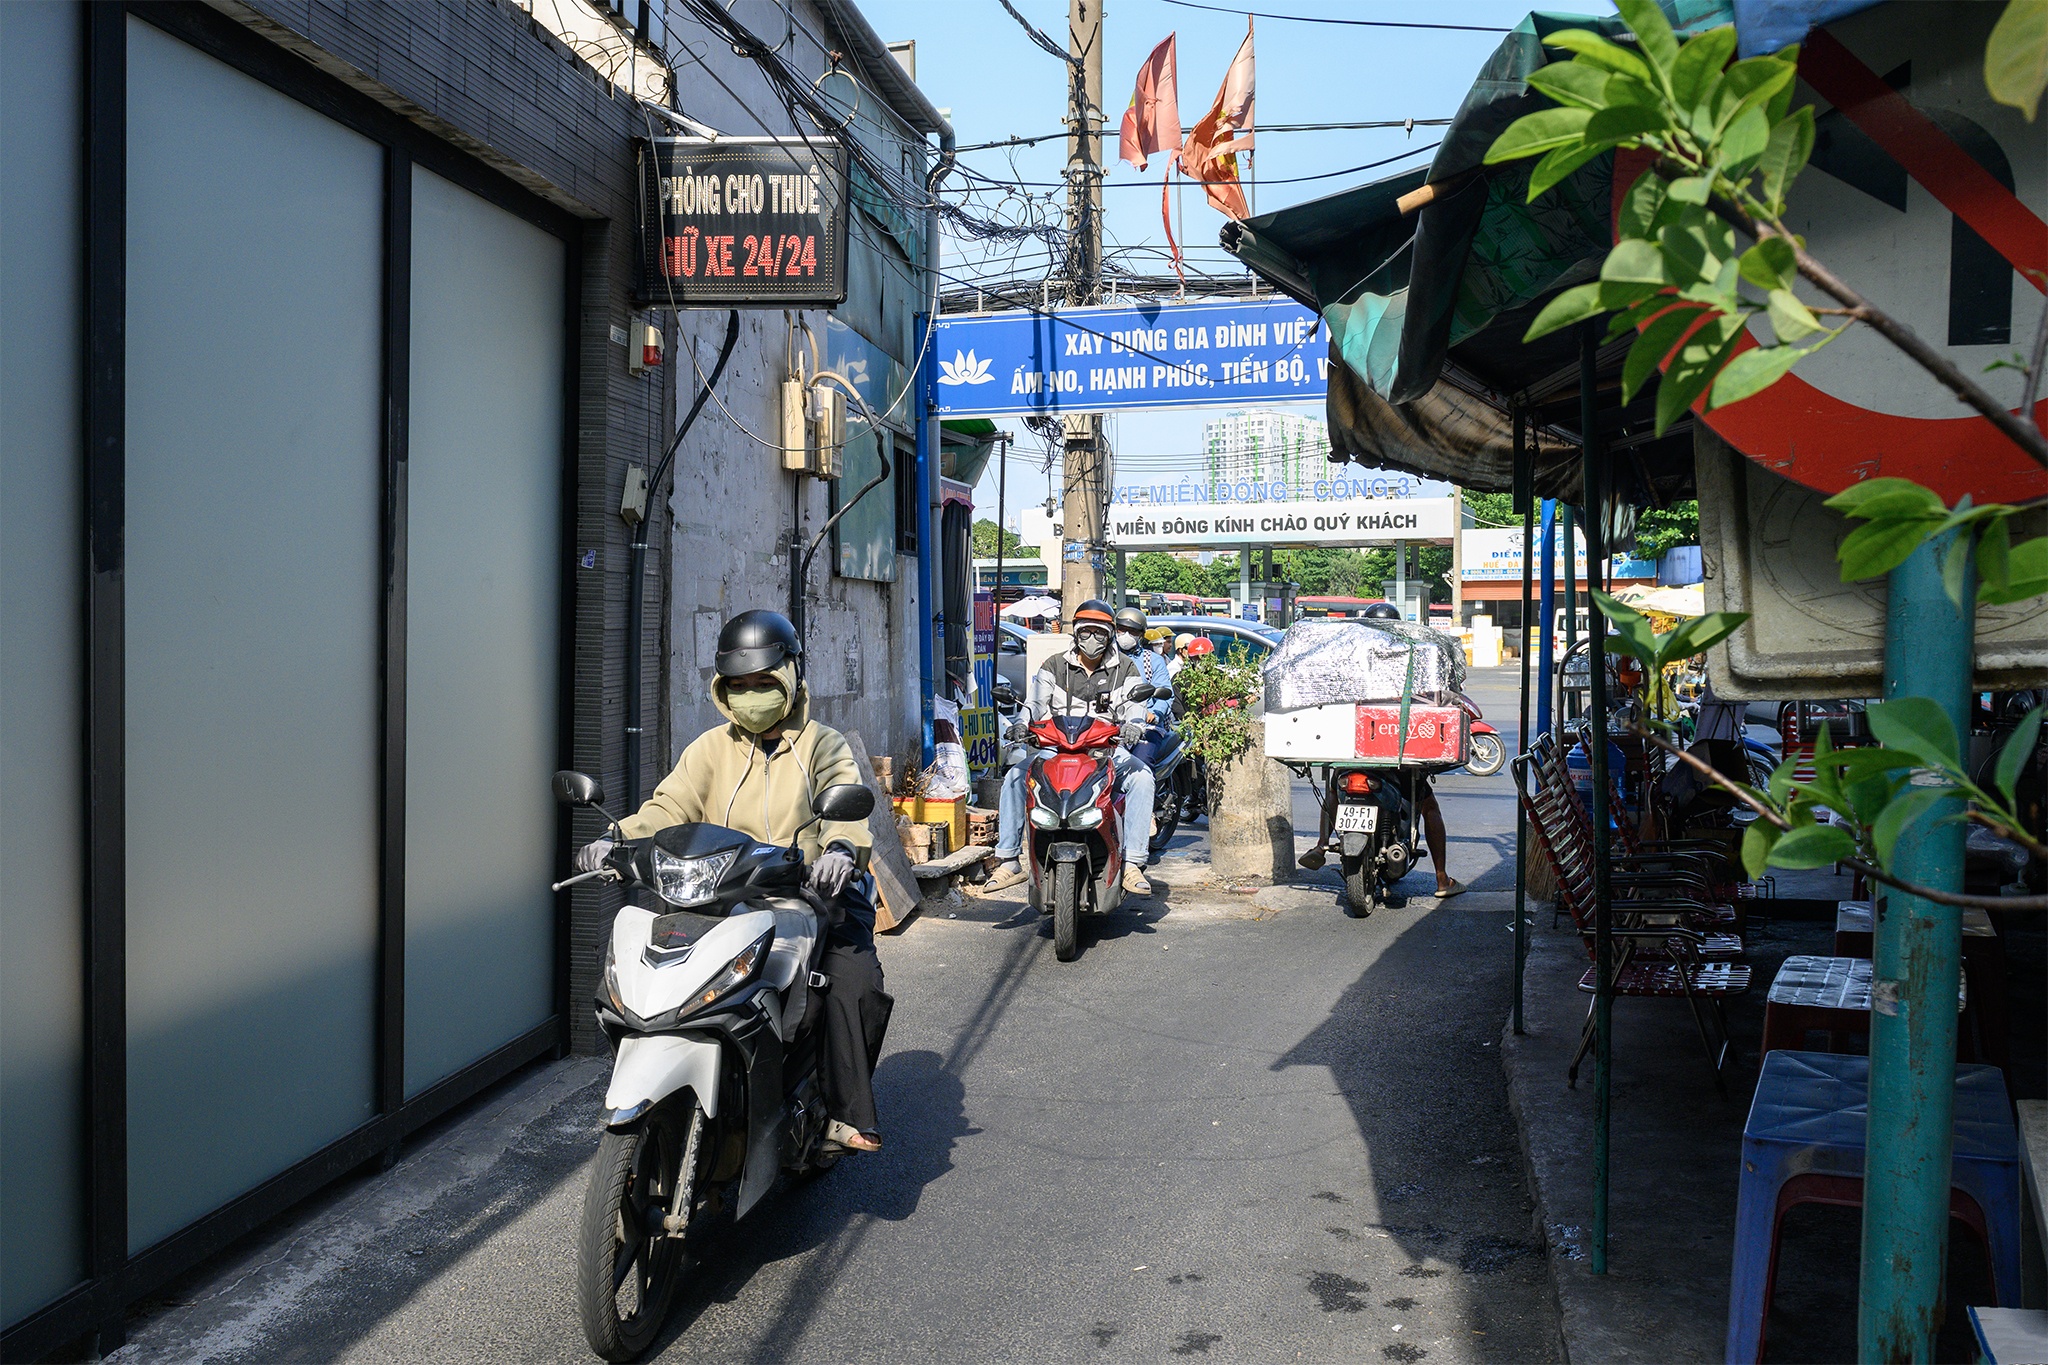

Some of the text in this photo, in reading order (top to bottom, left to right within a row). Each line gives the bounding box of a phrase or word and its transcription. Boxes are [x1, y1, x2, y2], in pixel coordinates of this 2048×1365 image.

[661, 165, 821, 215] PHÒNG CHO THUÊ
[660, 225, 817, 278] GIỮ XE 24/24
[1065, 331, 1102, 356] XÂY
[1111, 326, 1168, 354] DỰNG
[1174, 326, 1208, 350] GIA
[1215, 320, 1267, 348] ĐÌNH
[1274, 316, 1317, 349] VIỆT
[1010, 364, 1043, 394] ẤM
[1050, 368, 1083, 395] NO,
[1089, 362, 1147, 394] HẠNH
[1152, 359, 1214, 389] PHÚC,
[1221, 353, 1269, 385] TIẾN
[1276, 354, 1311, 386] BỘ,
[1111, 485, 1140, 504] XE
[1150, 475, 1207, 503] MIỀN
[1217, 477, 1287, 502] ĐÔNG
[1313, 467, 1388, 499] CỔNG
[1397, 477, 1410, 497] 3
[1116, 516, 1156, 535] MIỀN
[1162, 517, 1208, 534] ĐÔNG
[1214, 516, 1255, 533] KÍNH
[1260, 514, 1307, 532] CHÀO
[1313, 513, 1350, 531] QUÝ
[1356, 512, 1417, 530] KHÁCH
[1338, 817, 1374, 830] 307.48
[1343, 806, 1371, 818] 49-F1
